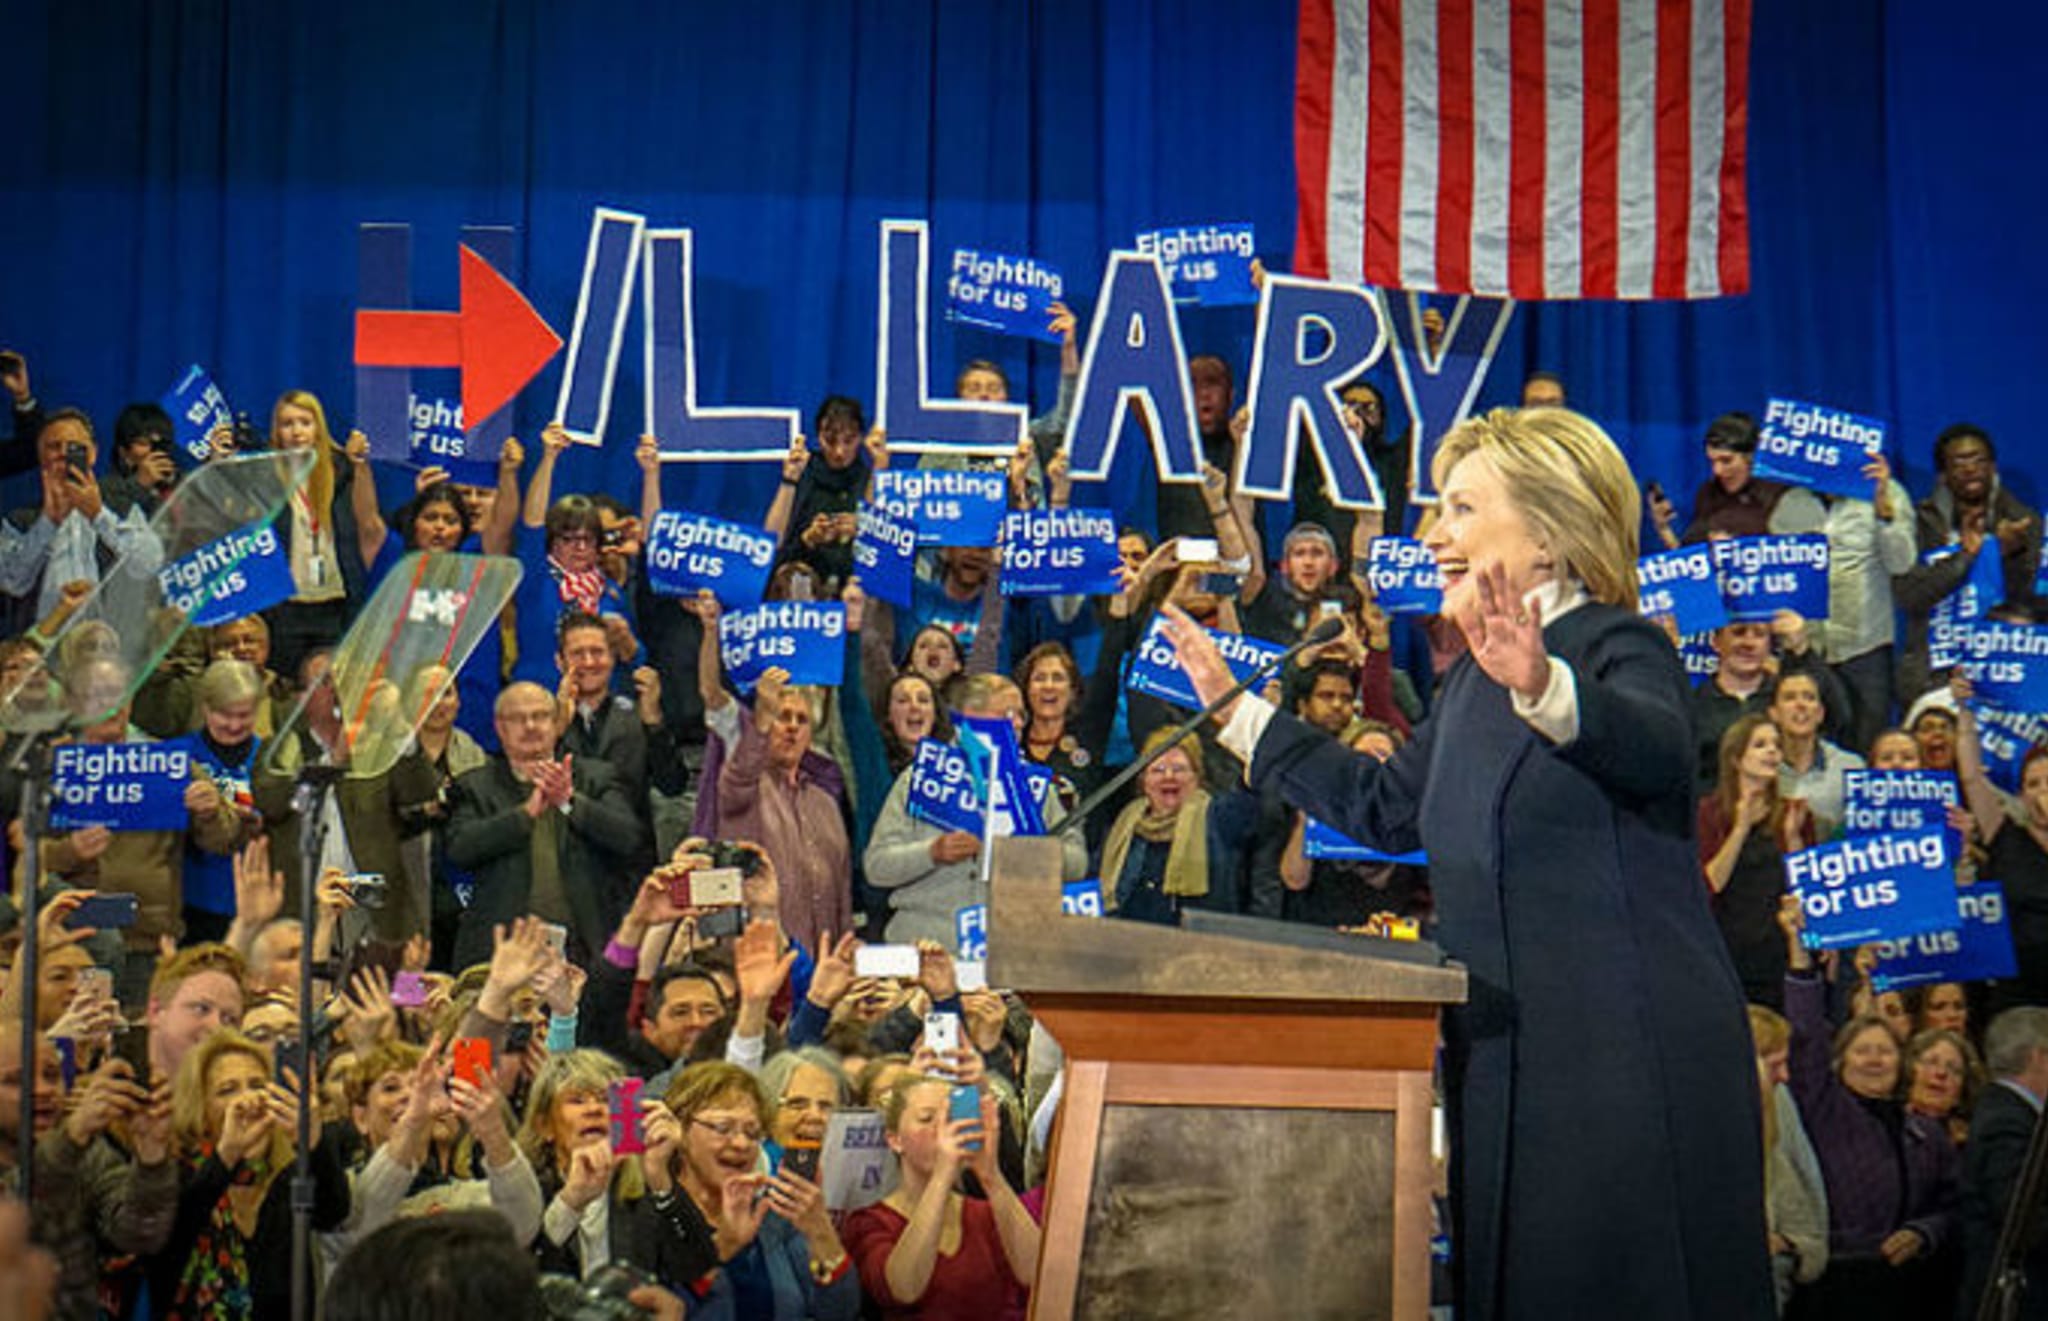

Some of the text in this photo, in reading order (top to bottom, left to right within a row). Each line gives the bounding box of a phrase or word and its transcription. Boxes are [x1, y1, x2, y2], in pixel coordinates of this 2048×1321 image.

[1136, 226, 1254, 262] Fighting
[953, 249, 1062, 298] Fighting
[1183, 260, 1218, 281] us
[949, 275, 1028, 312] for us
[1765, 400, 1883, 453] Fighting
[430, 434, 465, 458] us
[1759, 426, 1840, 466] for us
[874, 471, 1003, 501] Fighting
[925, 500, 962, 520] us
[653, 512, 775, 567] Fighting
[1006, 510, 1116, 547] Fighting
[158, 527, 277, 594] Fighting
[647, 539, 724, 577] for us
[1003, 542, 1085, 570] for us
[1713, 536, 1828, 574] Fighting
[210, 571, 247, 600] us
[1368, 564, 1411, 591] for
[1716, 571, 1798, 596] for us
[1638, 590, 1675, 615] us
[721, 602, 843, 640] Fighting
[722, 636, 796, 670] for us
[1988, 661, 2024, 682] us
[56, 746, 188, 781] Fighting
[106, 782, 144, 803] us
[912, 768, 957, 803] for
[1846, 772, 1957, 807] Fighting
[1845, 802, 1923, 829] for us
[1785, 834, 1946, 887] Fighting
[1852, 879, 1899, 908] us
[1917, 930, 1961, 957] us
